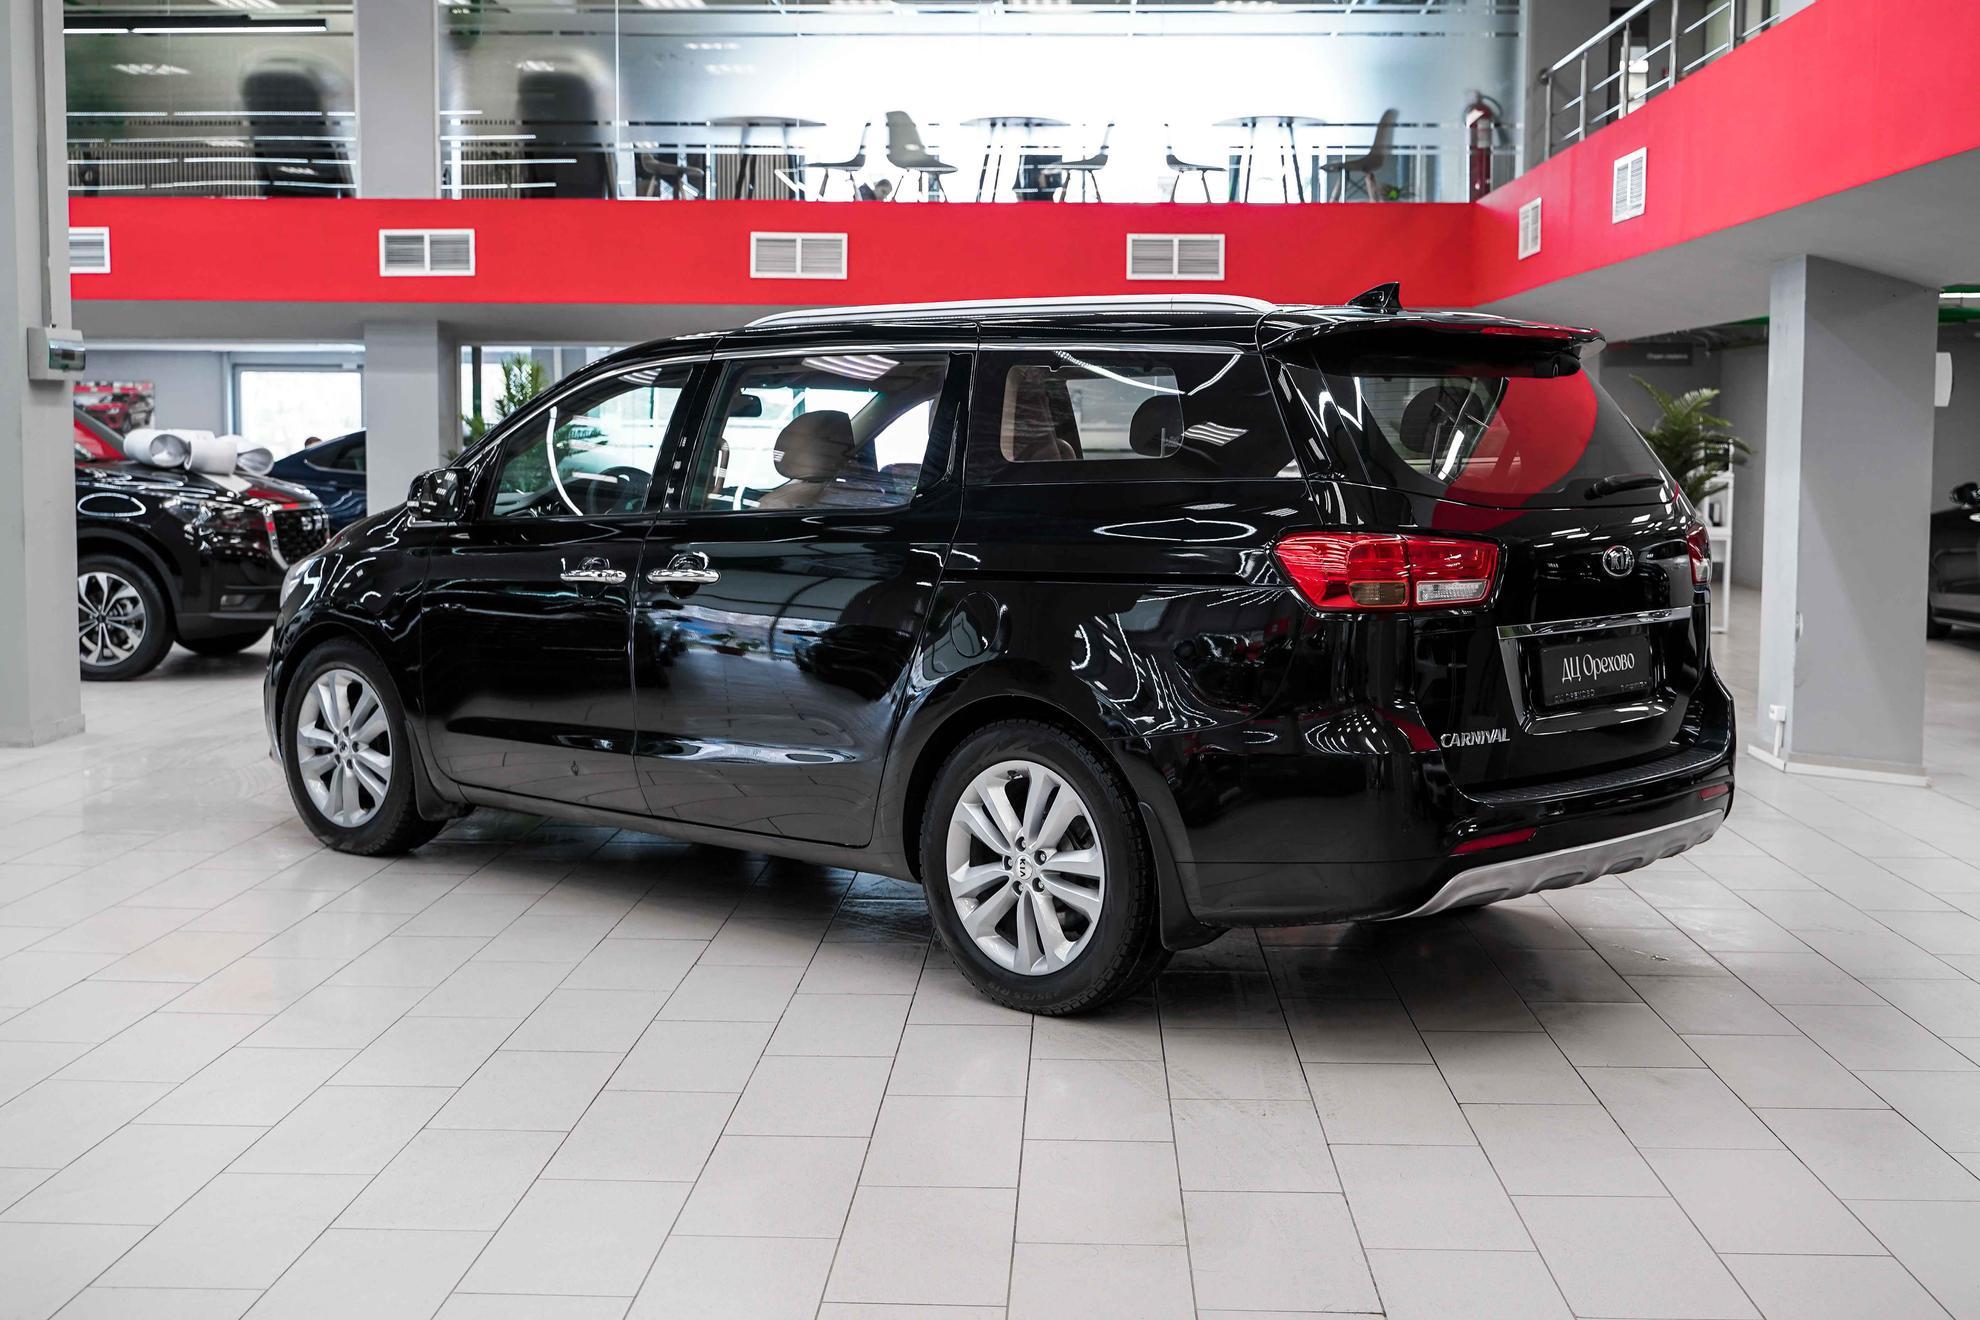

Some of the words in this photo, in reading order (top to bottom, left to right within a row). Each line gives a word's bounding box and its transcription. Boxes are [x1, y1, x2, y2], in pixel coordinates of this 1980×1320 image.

[1562, 655, 1582, 683] ДЦ
[1582, 652, 1635, 680] Орехово
[1440, 728, 1511, 748] CARNIVAL
